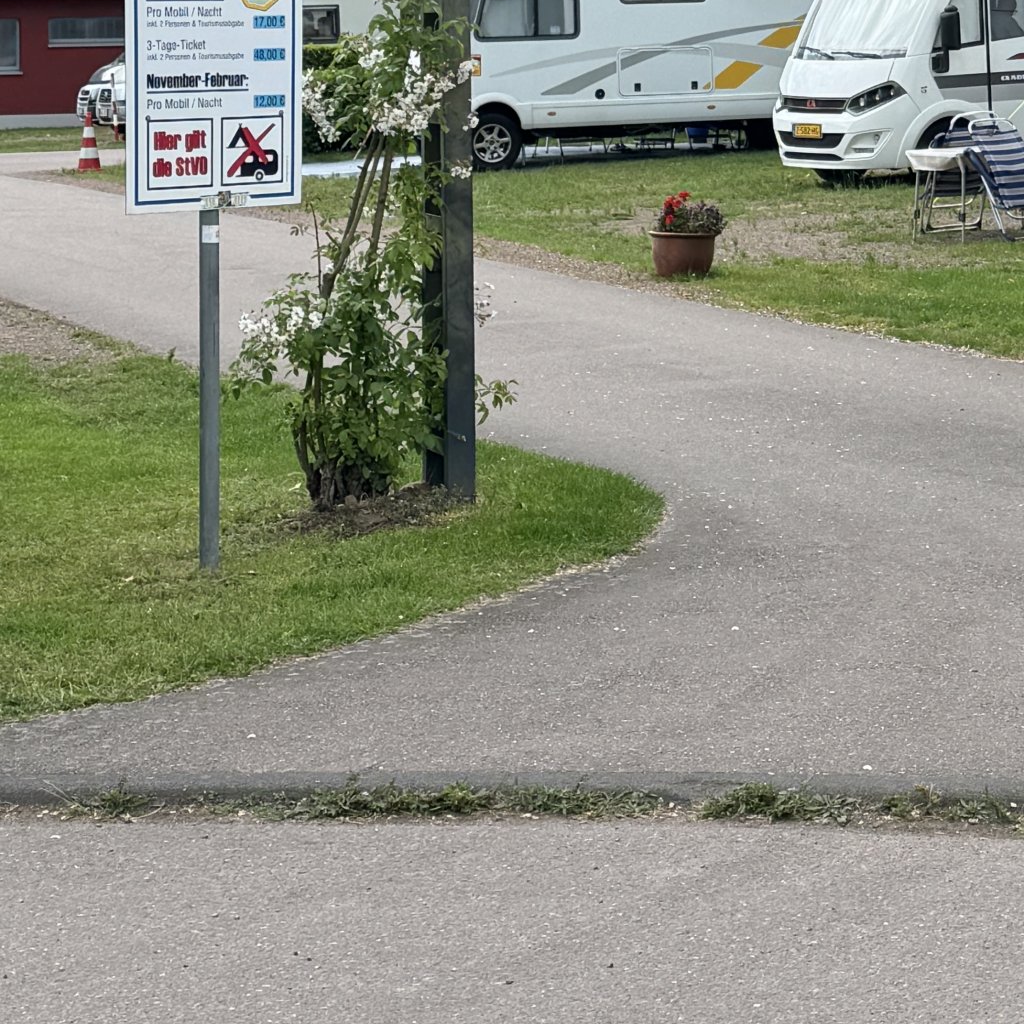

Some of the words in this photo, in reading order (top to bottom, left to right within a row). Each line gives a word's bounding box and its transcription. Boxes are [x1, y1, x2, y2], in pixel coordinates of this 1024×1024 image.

[146, 7, 162, 18] Pro
[164, 6, 189, 17] Mobil
[197, 6, 222, 17] Nacht
[164, 20, 191, 28] Personen
[146, 39, 206, 52] 3-Tage-Ticket
[164, 53, 191, 61] Personen
[146, 72, 249, 89] November-Februar:
[146, 98, 162, 110] Pro
[164, 98, 190, 109] Mobil
[197, 97, 223, 109] Nacht
[153, 130, 182, 151] Hier
[185, 129, 207, 152] gilt
[152, 157, 173, 178] die
[175, 156, 208, 177] StVO
